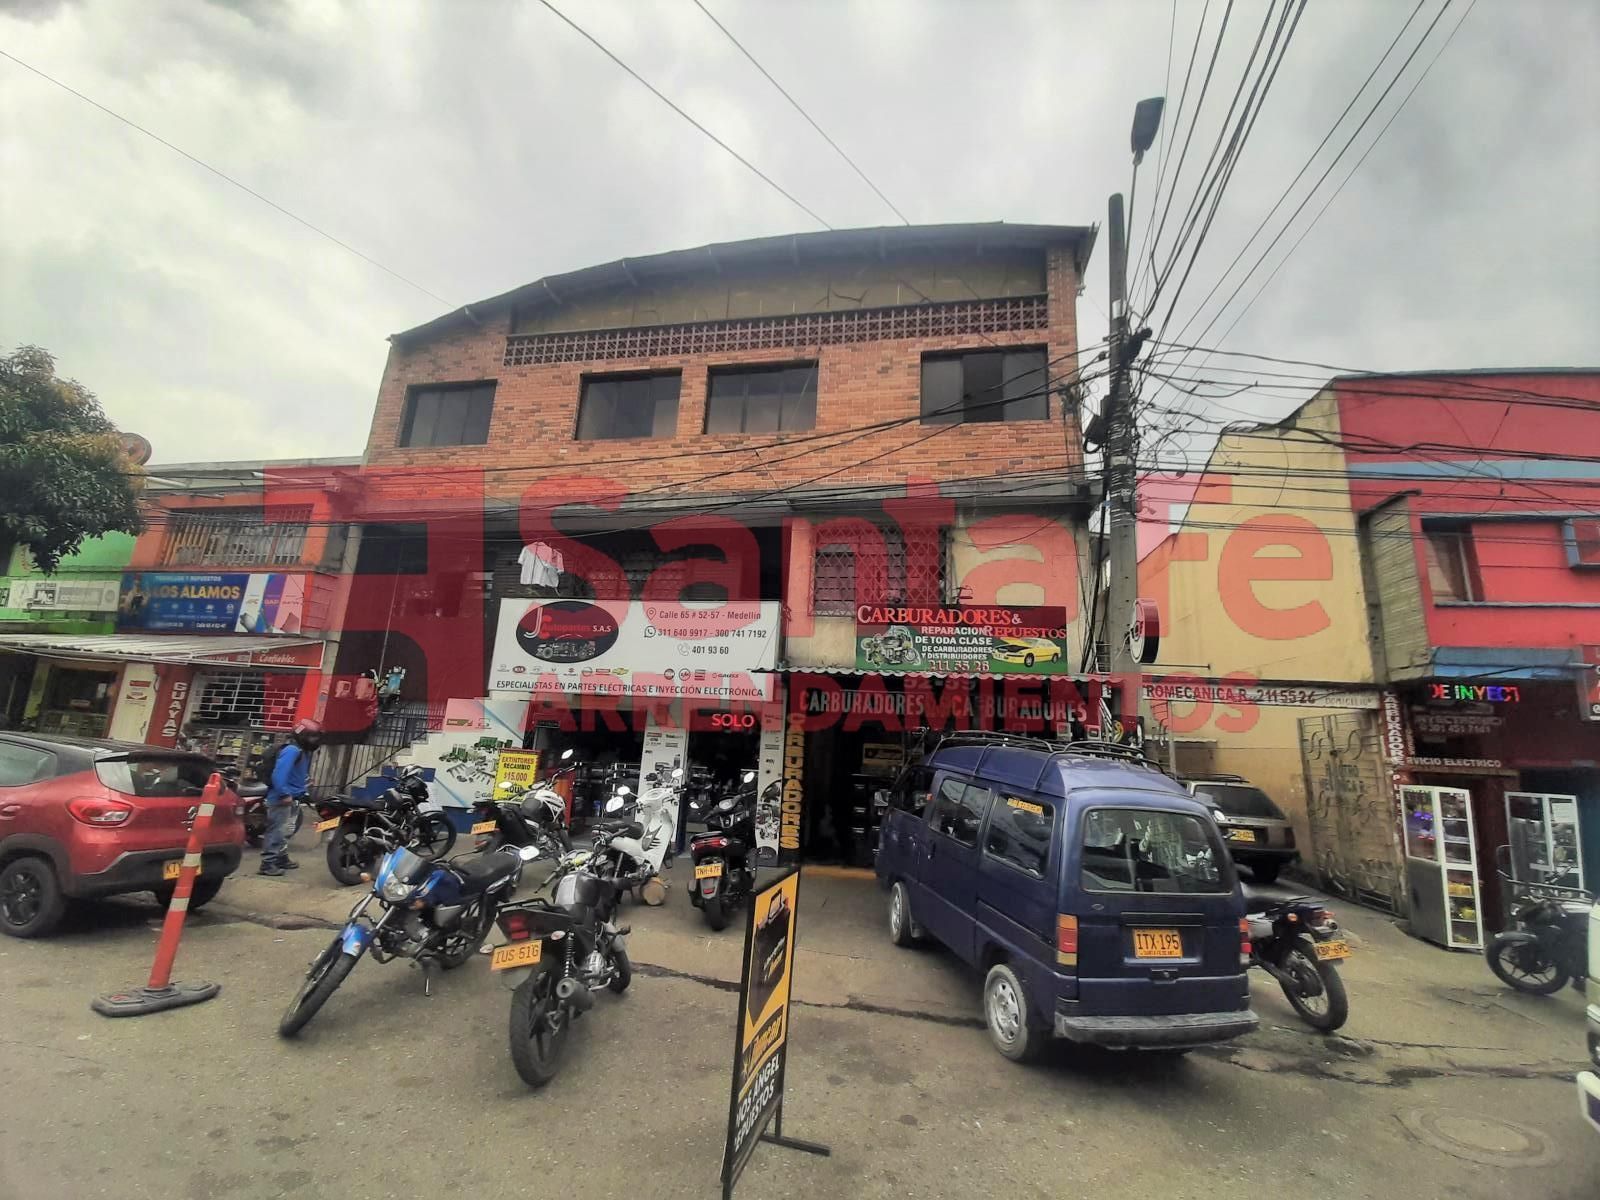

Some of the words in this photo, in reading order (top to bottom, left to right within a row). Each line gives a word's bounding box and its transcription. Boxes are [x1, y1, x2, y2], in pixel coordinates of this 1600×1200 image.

[659, 611, 678, 619] Calle
[681, 611, 689, 619] 65
[698, 611, 720, 619] 52-57
[857, 605, 1011, 624] CARBURADORES
[1011, 613, 1022, 624] &
[592, 624, 612, 633] S.A.S
[657, 628, 671, 637] 311
[673, 629, 688, 637] 640
[689, 629, 707, 637] 9917
[715, 629, 730, 637] 300
[732, 630, 746, 638] 741
[748, 630, 767, 639] 7192
[984, 625, 1067, 639] REPUESTOS
[915, 636, 928, 644] DE
[930, 637, 957, 645] TODA
[959, 637, 993, 646] CLASE
[692, 646, 705, 654] 401
[708, 646, 717, 654] 93
[922, 645, 932, 653] DE
[933, 646, 994, 654] CARBURADORES
[928, 653, 988, 661] DISTRIBUIDORES
[928, 660, 949, 672] 211
[496, 680, 553, 691] ESPECIALISTAS
[554, 682, 566, 691] EN
[567, 682, 597, 691] PARTES
[648, 685, 653, 693] E
[799, 690, 925, 717] CARBURADORES
[161, 682, 188, 737] GUAYAS
[712, 713, 754, 728] SOLO
[502, 756, 534, 764] EXTINTORES
